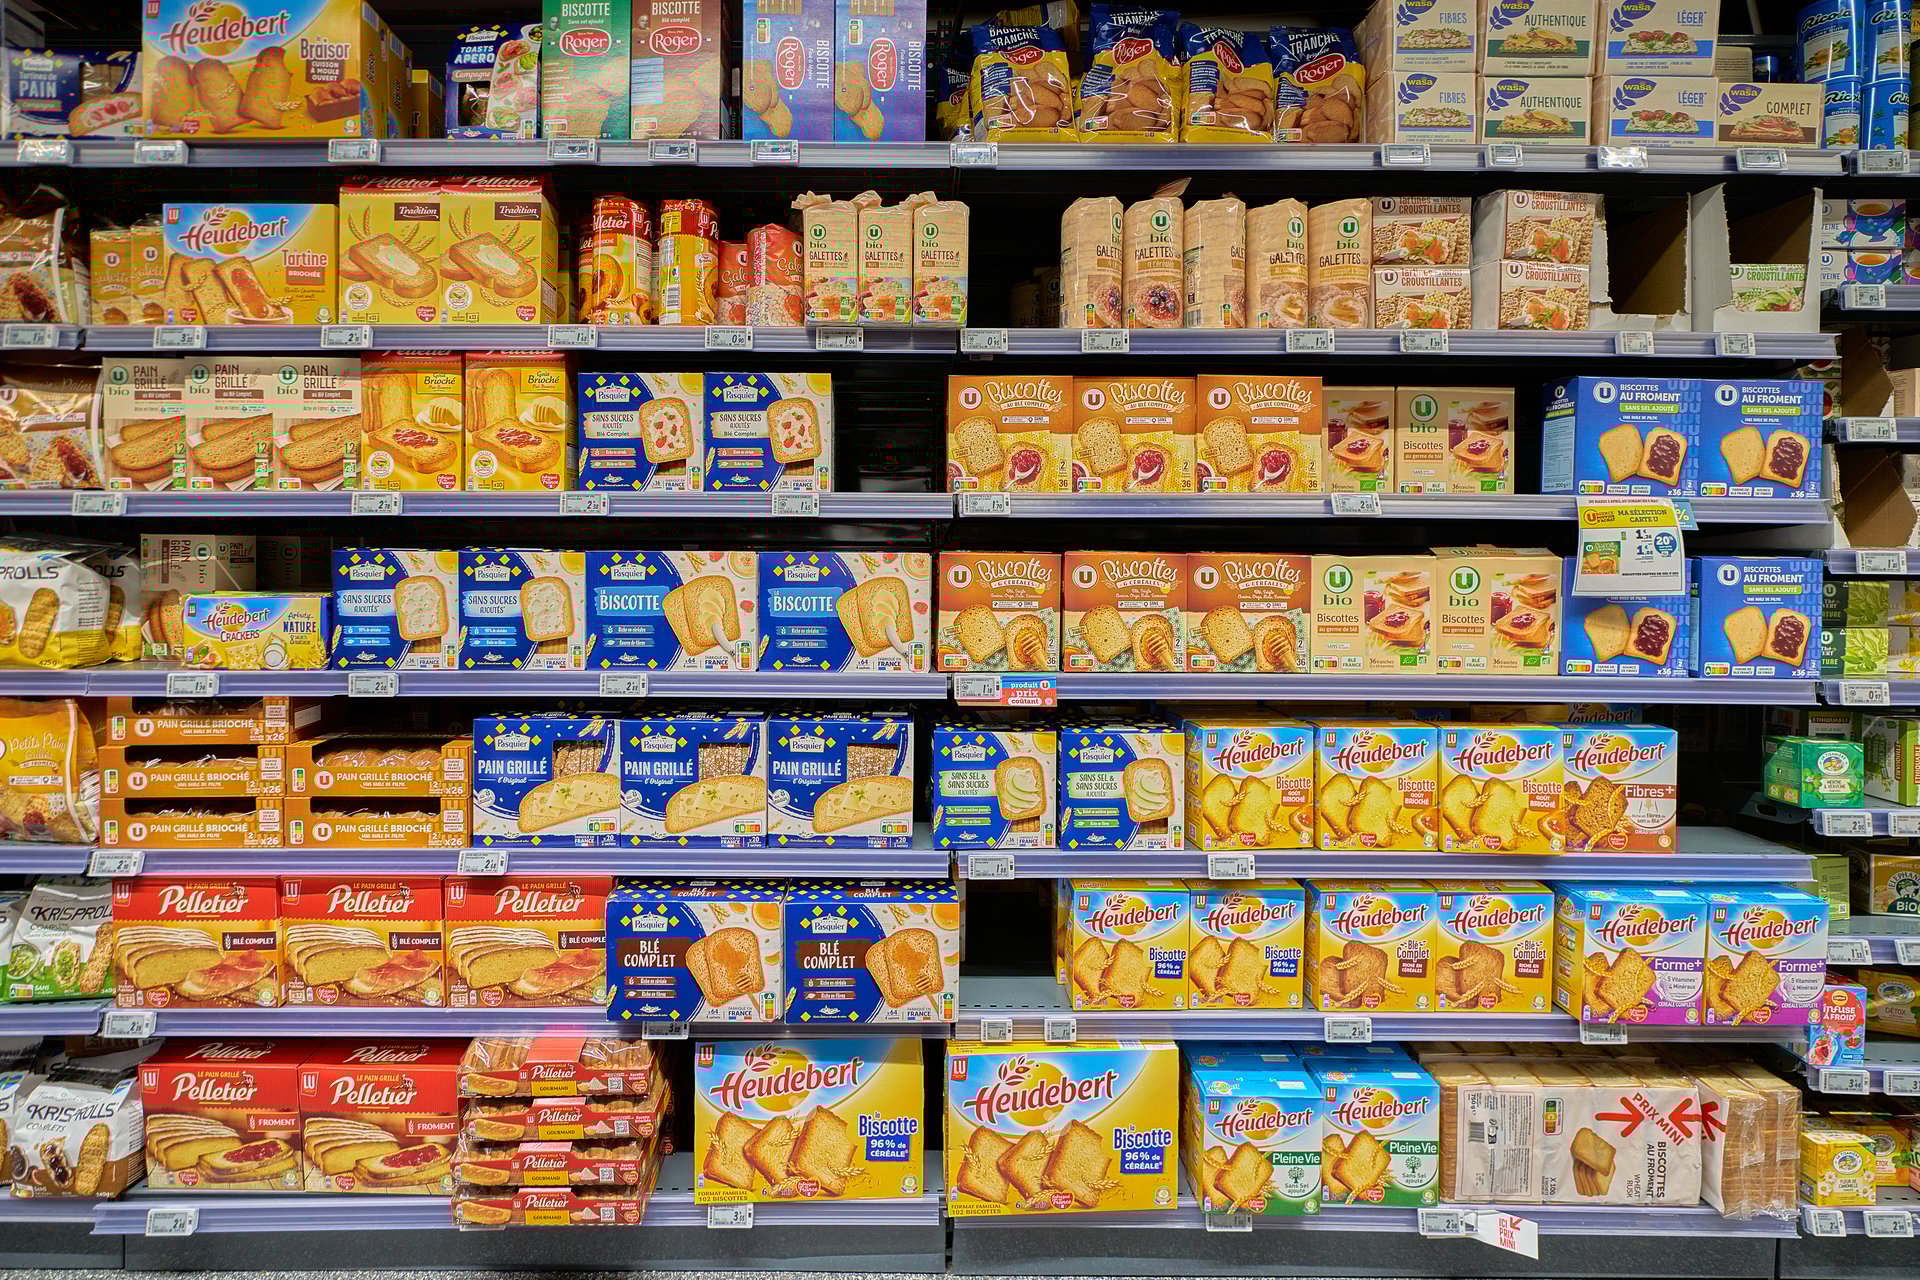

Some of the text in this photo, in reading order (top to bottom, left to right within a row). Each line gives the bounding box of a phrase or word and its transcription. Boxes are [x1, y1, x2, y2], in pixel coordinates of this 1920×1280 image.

[562, 3, 610, 17] BISCOTTE
[652, 1, 700, 15] BISCOTTE
[1524, 14, 1586, 27] AUTHENTIQUE
[160, 10, 291, 55] Heudebert
[565, 33, 608, 53] Roger
[655, 32, 697, 52] Roger
[301, 39, 350, 60] Braisor
[460, 45, 494, 53] TOASTS
[311, 61, 339, 69] CUISSON
[455, 54, 495, 65] APERO
[778, 42, 798, 88] Roger
[816, 40, 830, 89] BISCOTTE
[455, 70, 491, 80] Campagne
[1299, 56, 1344, 83] Roger
[312, 74, 338, 82] OUVERT
[1439, 92, 1466, 104] FIBRES
[1678, 91, 1704, 104] LÉGER
[1731, 88, 1757, 97] wasa
[1767, 101, 1812, 115] COMPLET
[1399, 204, 1461, 214] CROUSTILLANTES
[1531, 200, 1587, 211] CROUSTILLANTES
[399, 206, 438, 218] Tradition
[178, 217, 288, 252] Heudebert
[809, 240, 827, 248] bio
[865, 240, 882, 249] bio
[1337, 240, 1360, 249] bio
[282, 249, 329, 267] Tartine
[809, 251, 843, 261] GALETTES
[865, 251, 898, 261] GALETTES
[1319, 253, 1361, 266] GALETTES
[288, 270, 321, 278] BRIOCHÉE
[1525, 271, 1581, 282] CROUSTILLANTES
[215, 364, 239, 376] PAIN
[215, 376, 248, 389] GRILLÉ
[527, 375, 560, 384] Brioché
[726, 390, 756, 400] Pasquier
[983, 379, 1064, 405] Biscottes
[1742, 386, 1780, 394] BISCOTTES
[1742, 395, 1803, 405] AU FROMENT
[1774, 406, 1797, 415] AJOUTÉ
[719, 413, 762, 423] SANS SUCRES
[1409, 423, 1438, 434] bio
[1403, 441, 1443, 451] Biscottes
[1059, 479, 1068, 488] 36
[352, 569, 383, 578] Pasquier
[787, 570, 817, 579] Pasquier
[974, 558, 1053, 581] Biscottes
[1744, 574, 1804, 583] AU FROMENT
[342, 594, 391, 604] SANS SUCRES
[773, 595, 833, 612] BISCOTTE
[1323, 595, 1352, 606] bio
[353, 604, 378, 613] AJOUTÉS
[202, 608, 271, 631] Heudebert
[1317, 613, 1359, 623] Biscottes
[283, 622, 316, 633] NATURE
[220, 630, 259, 642] CRACKERS
[1011, 681, 1038, 689] produit
[1016, 688, 1038, 699] prix
[1011, 697, 1039, 705] coûtant
[643, 741, 673, 750] Pasquier
[1212, 738, 1305, 771] Heudebert
[1568, 743, 1666, 772] Heudebert
[624, 759, 694, 776] PAIN GRILLÉ
[948, 780, 989, 789] SANS SUCRES
[1276, 777, 1311, 790] Biscotte
[151, 823, 248, 833] PAIN GRILLÉ BRIOCHÉ
[261, 838, 279, 846] x26
[158, 884, 249, 915] Pelletier
[1084, 903, 1182, 934] Heudebert
[819, 942, 840, 956] BLÉ
[1524, 940, 1535, 949] Blé
[1150, 947, 1186, 961] Biscotte
[1513, 949, 1546, 961] Complet
[803, 955, 855, 970] COMPLET
[1885, 1007, 1906, 1015] DÉTOX
[171, 1073, 258, 1101] Pelletier
[710, 1057, 863, 1110] Heudebert
[1632, 1092, 1660, 1120] PRIX
[26, 1103, 116, 1123] KRISPROLLS
[259, 1118, 296, 1126] FROMENT
[859, 1114, 918, 1137] Biscotte
[1656, 1118, 1684, 1146] MINI
[870, 1148, 906, 1157] CÉRÉALE
[1272, 1153, 1320, 1164] Pleine Vie
[1646, 1144, 1655, 1198] AU FROMENT
[1657, 1142, 1666, 1198] BISCOTTES
[1499, 1218, 1507, 1227] ICI
[1499, 1228, 1514, 1240] PRIX
[1500, 1237, 1515, 1248] MINI
